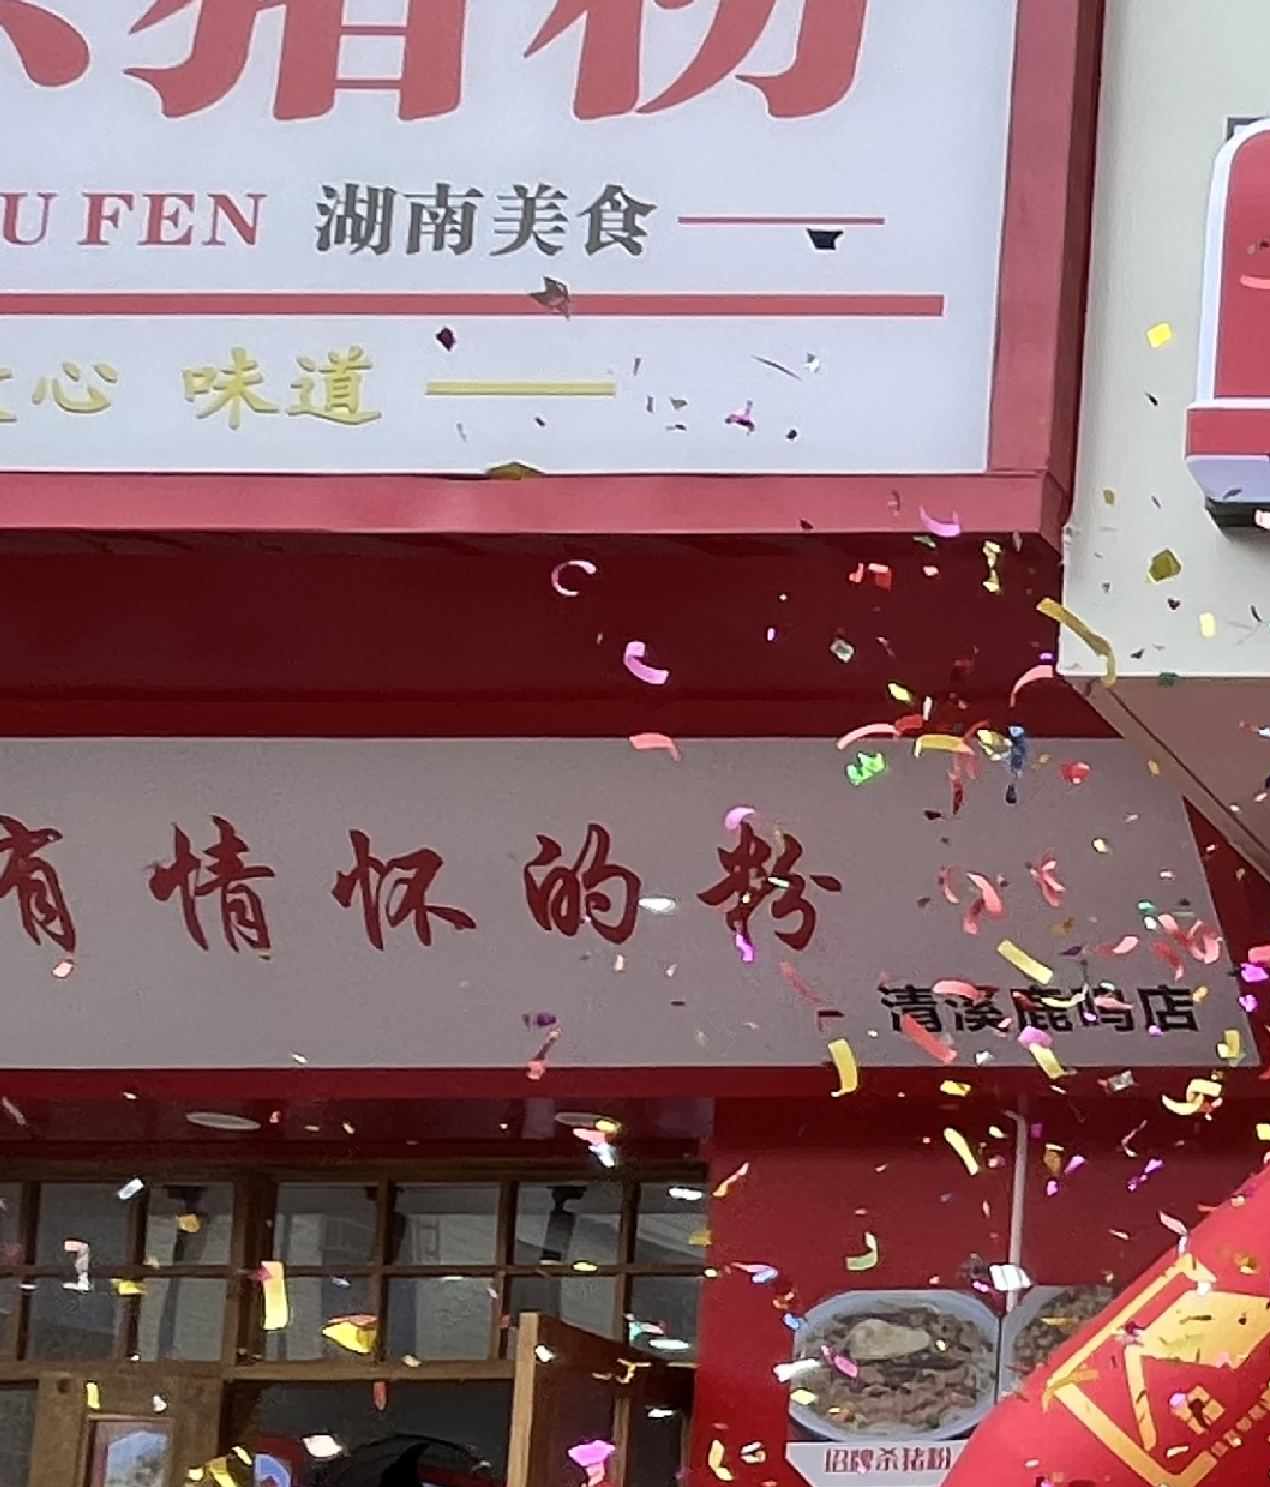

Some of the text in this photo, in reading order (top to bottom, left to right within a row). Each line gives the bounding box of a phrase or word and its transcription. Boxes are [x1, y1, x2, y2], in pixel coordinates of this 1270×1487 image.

[82, 193, 266, 245] FEN
[315, 182, 659, 257] 湖南美食
[183, 345, 383, 430] 味道
